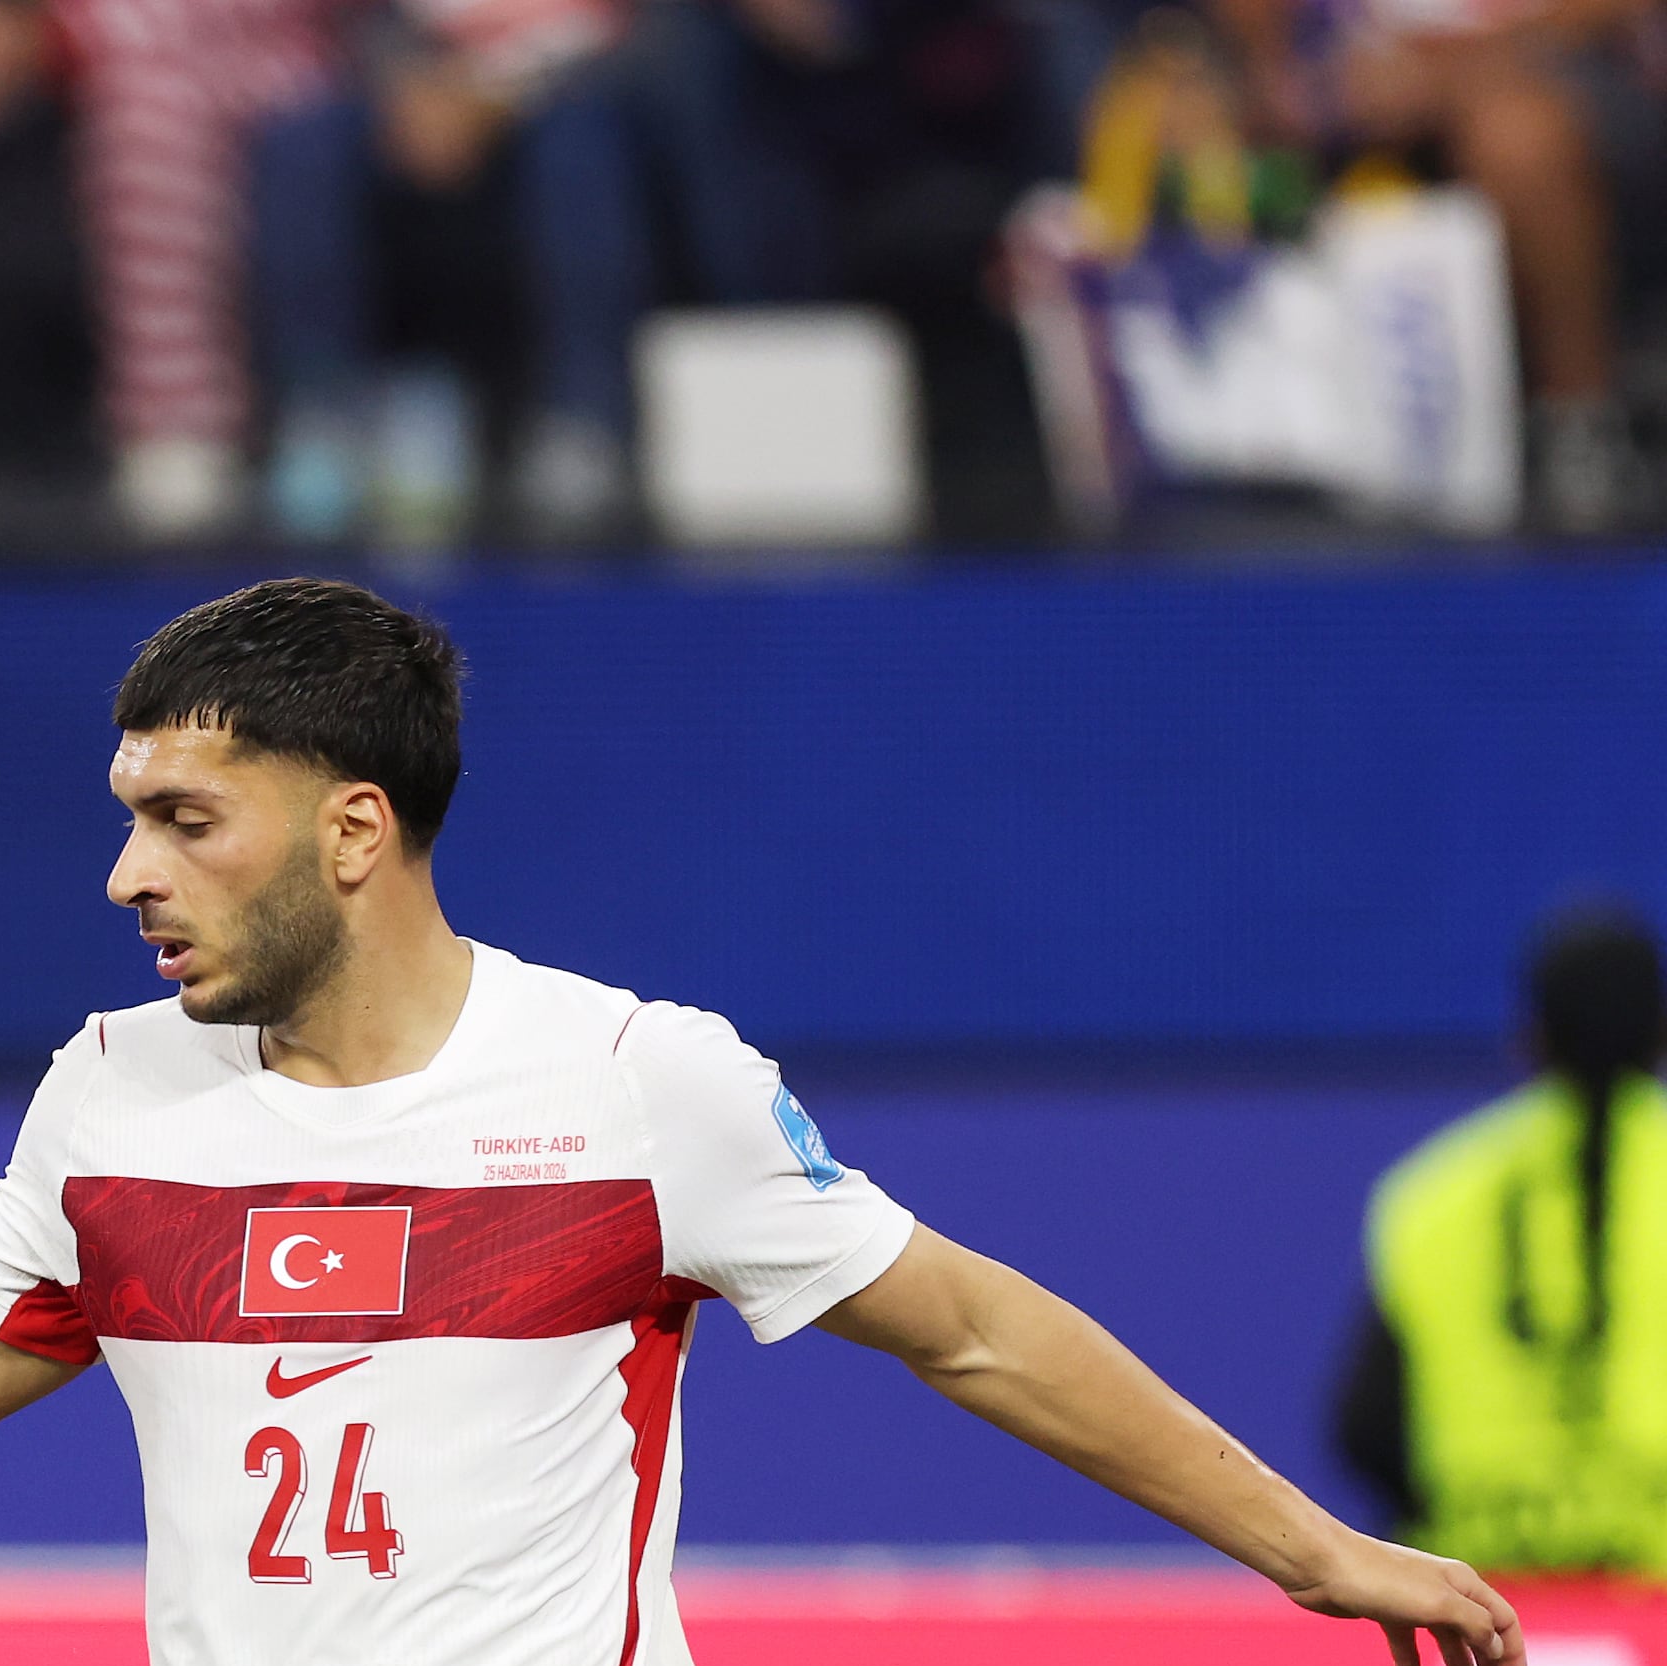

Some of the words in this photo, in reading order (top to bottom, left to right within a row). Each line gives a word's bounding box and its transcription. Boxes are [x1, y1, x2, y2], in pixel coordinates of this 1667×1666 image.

[472, 1135, 587, 1156] TÜRKİYE-ABD
[483, 1164, 496, 1181] 25
[543, 1162, 567, 1180] 2026
[243, 1423, 404, 1584] 24
